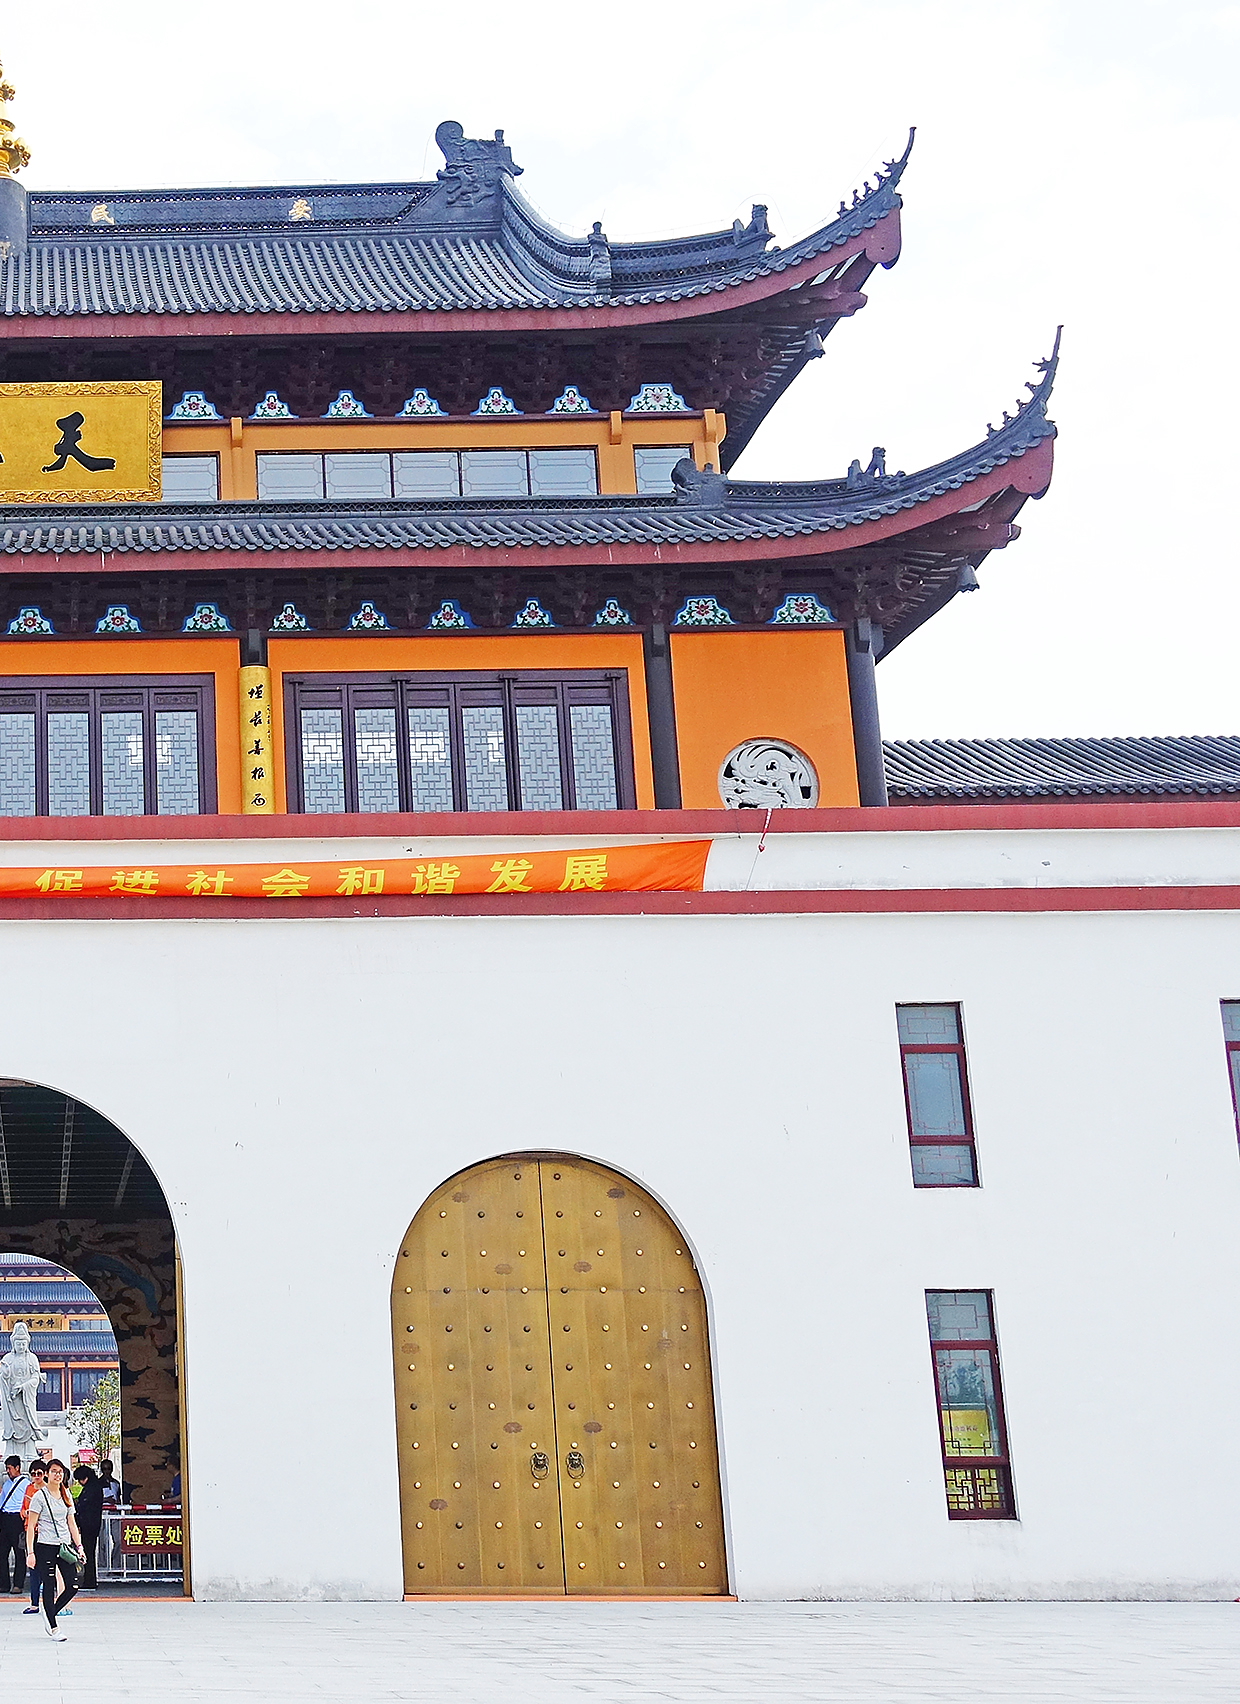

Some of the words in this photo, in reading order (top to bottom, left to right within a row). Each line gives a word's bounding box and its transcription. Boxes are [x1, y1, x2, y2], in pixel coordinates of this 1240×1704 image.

[35, 854, 608, 897] 促进社会和谐发展
[124, 1525, 182, 1545] 检票处
